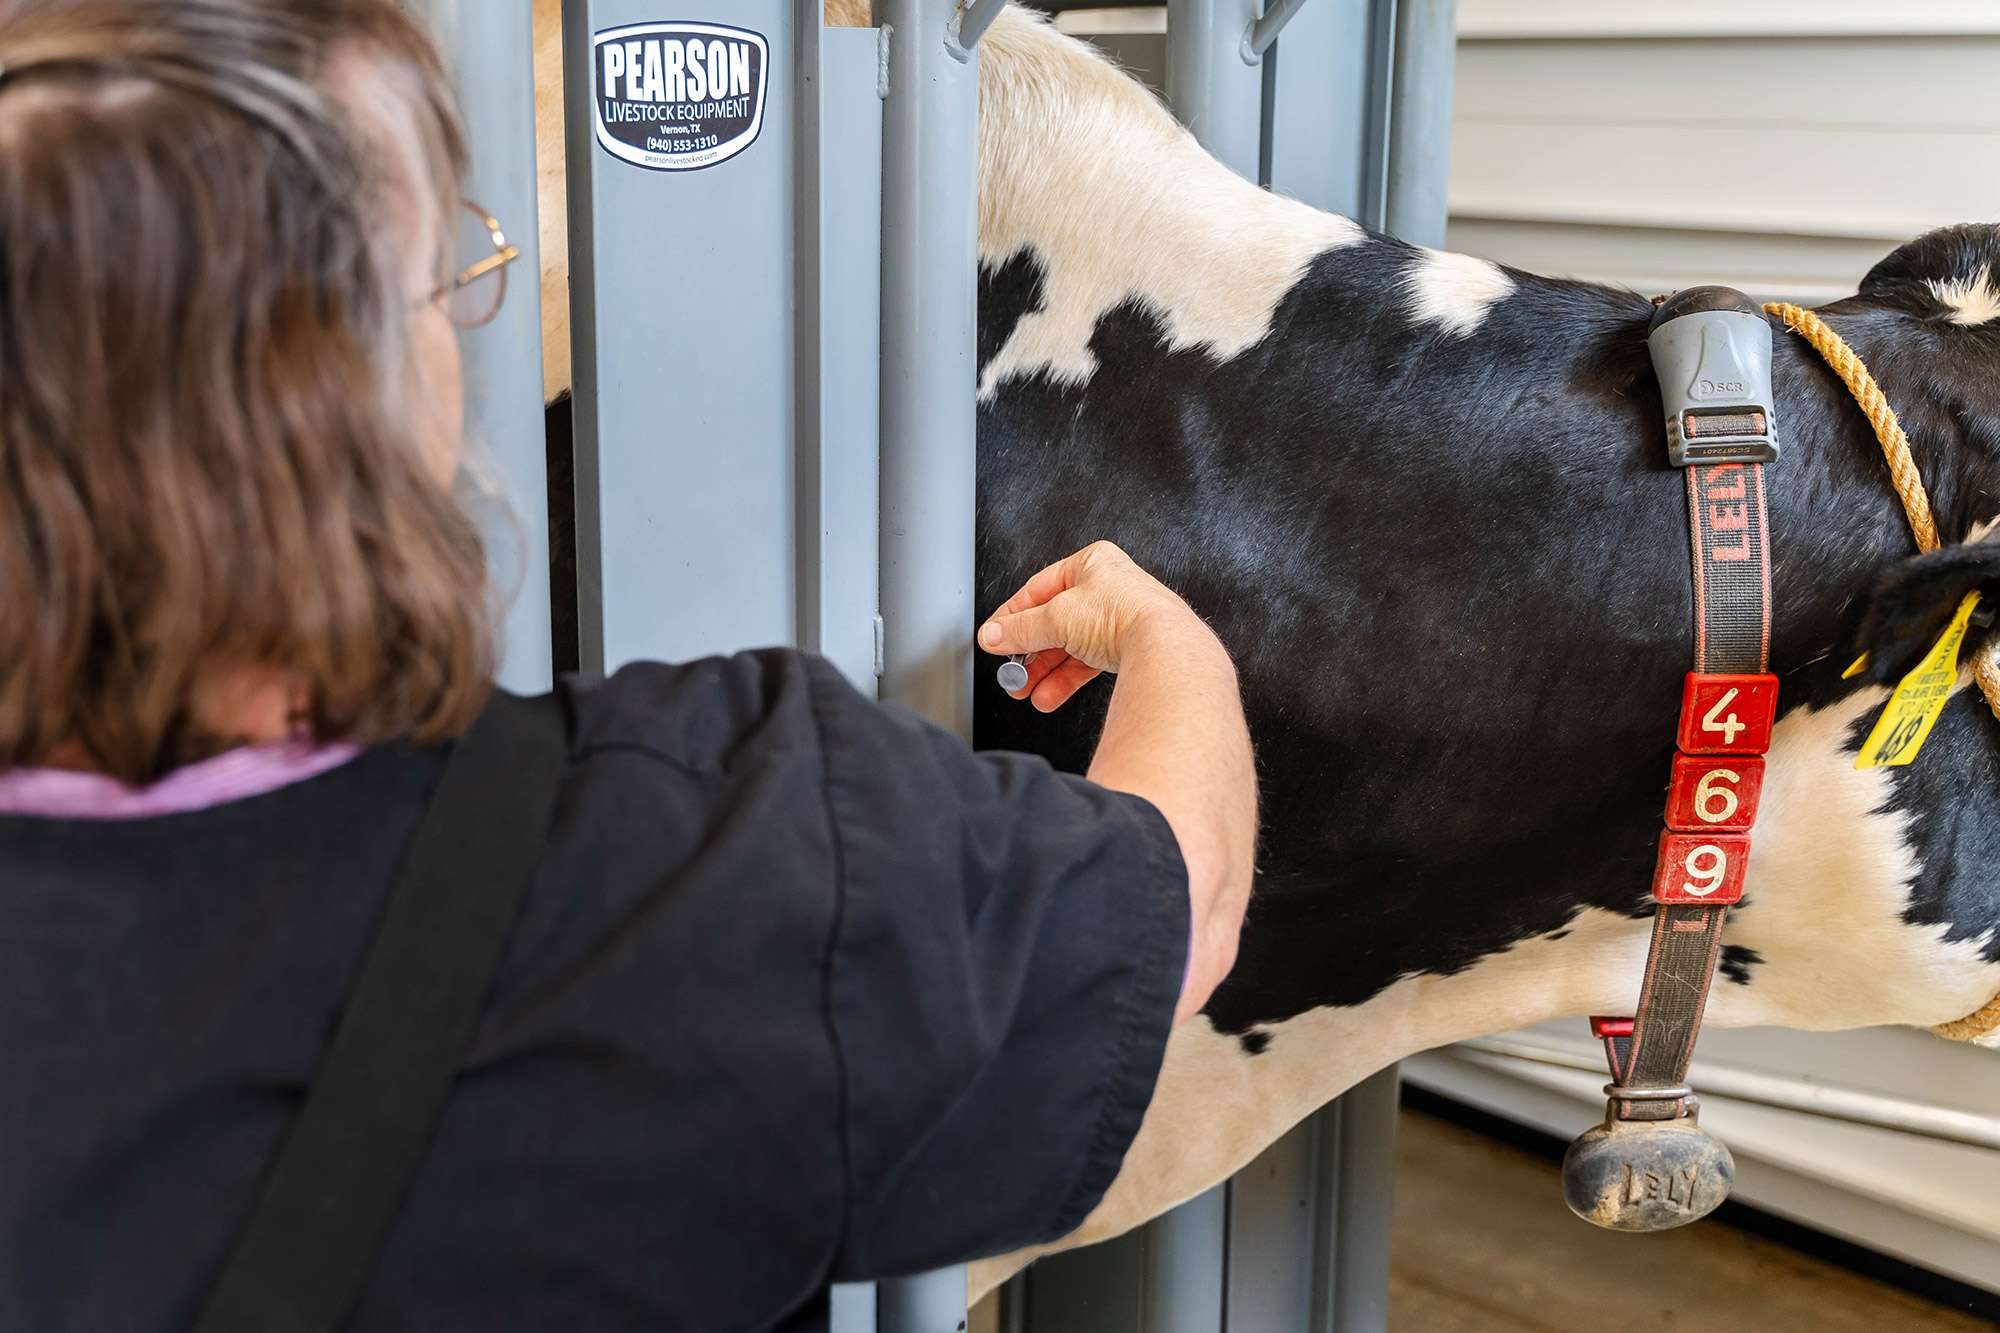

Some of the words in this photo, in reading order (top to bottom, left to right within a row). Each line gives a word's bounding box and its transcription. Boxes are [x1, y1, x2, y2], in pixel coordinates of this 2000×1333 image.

[603, 38, 750, 102] PEARSON
[605, 101, 675, 123] LIVESTOCK
[678, 96, 750, 121] EQUIPMENT
[647, 136, 672, 152] (940)
[673, 134, 718, 152] 553-1310
[1716, 382, 1744, 392] SCR
[1702, 688, 1746, 744] 4
[1694, 768, 1740, 823] 6
[1683, 844, 1727, 896] 9
[1620, 1160, 1699, 1209] LELY
